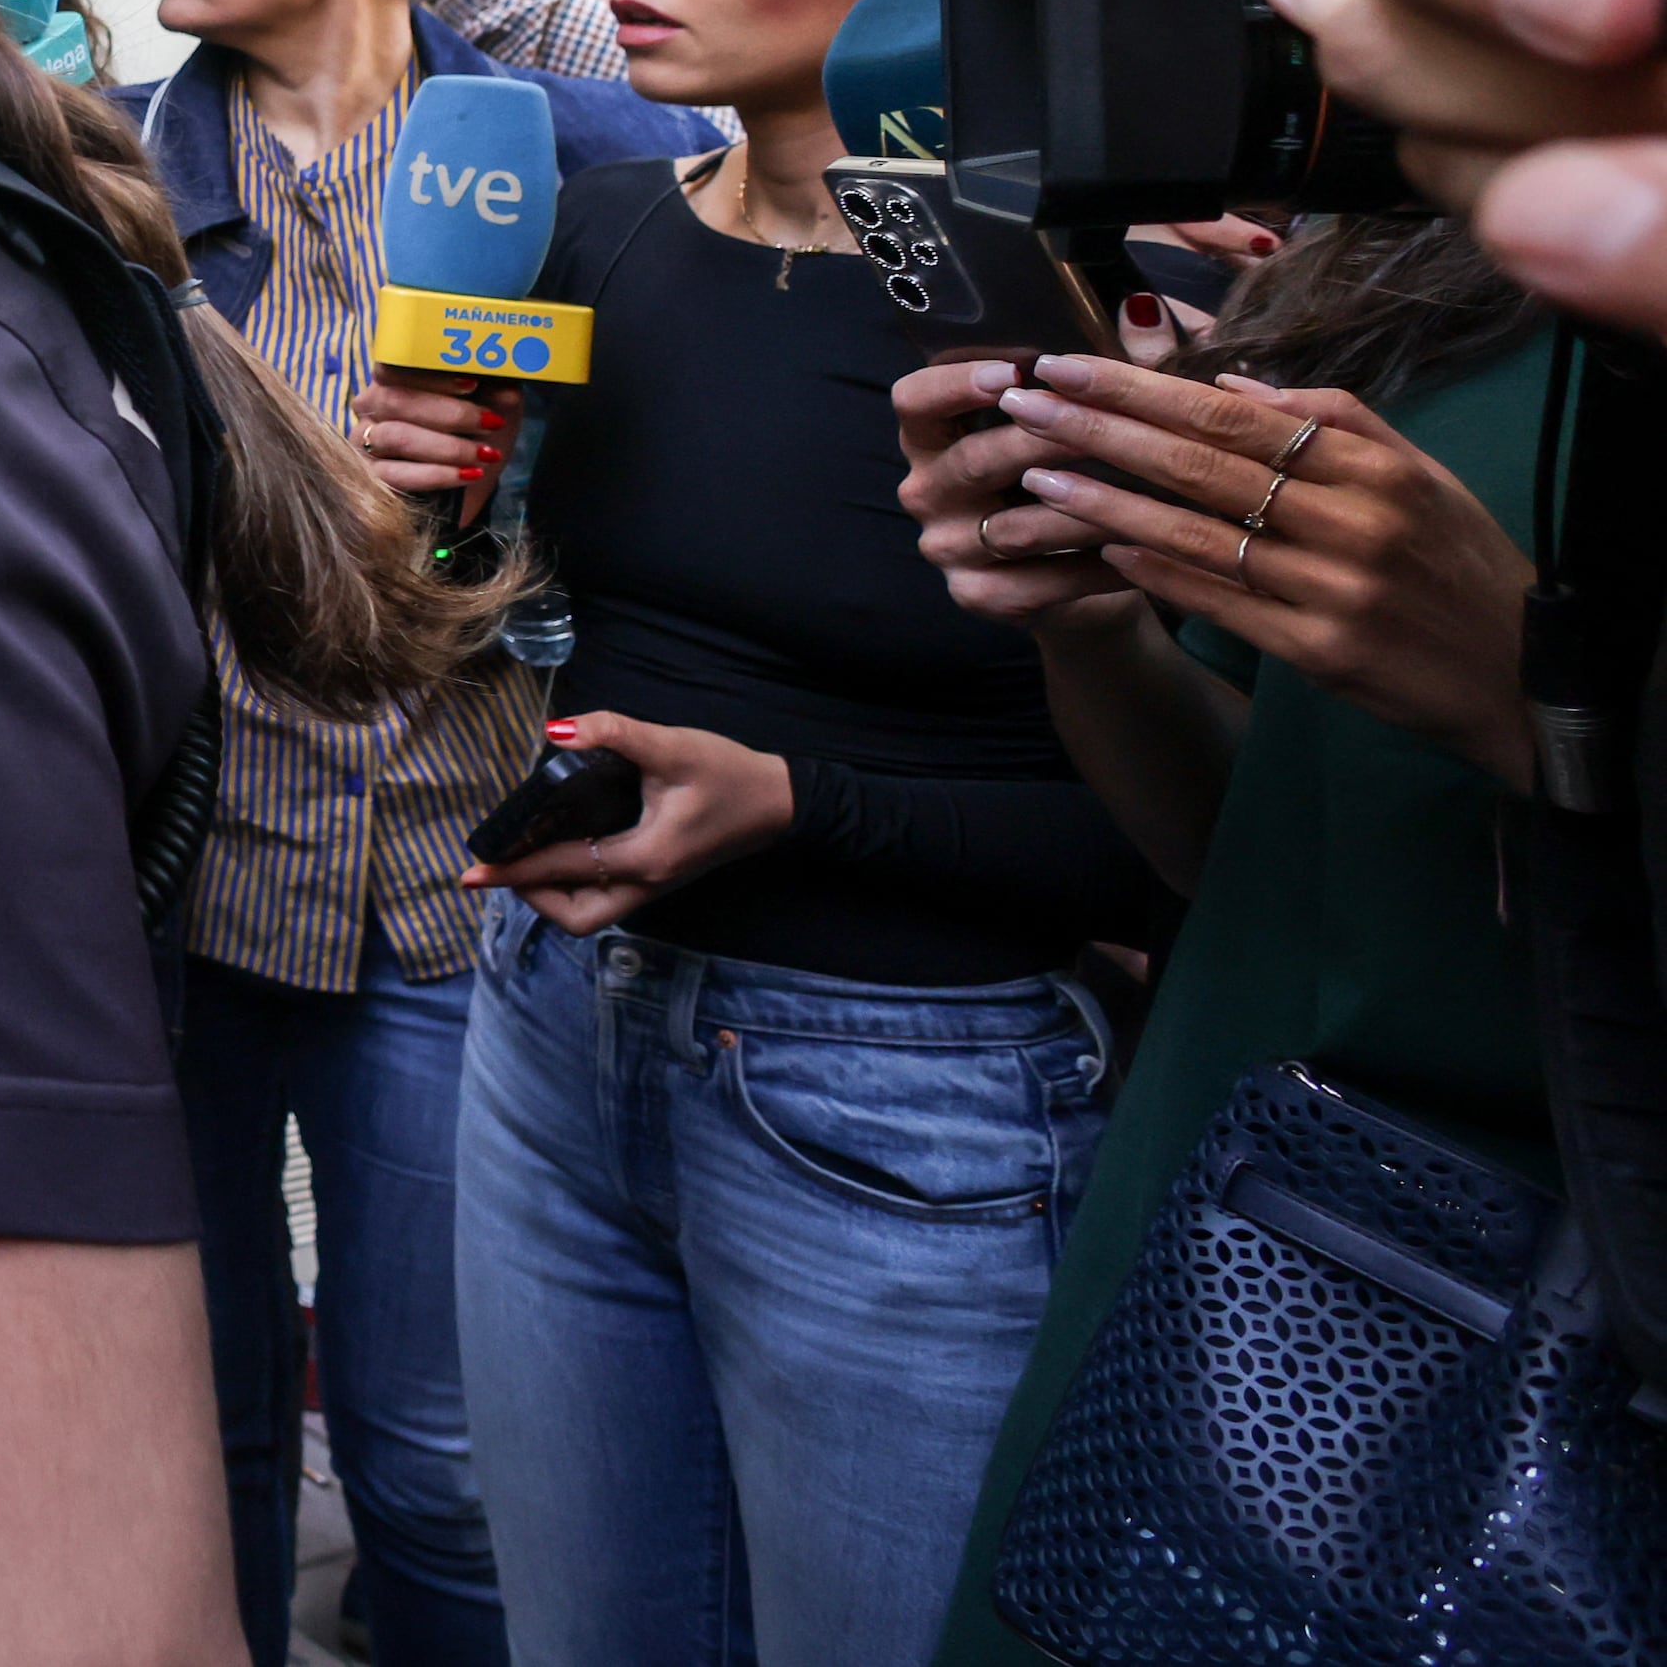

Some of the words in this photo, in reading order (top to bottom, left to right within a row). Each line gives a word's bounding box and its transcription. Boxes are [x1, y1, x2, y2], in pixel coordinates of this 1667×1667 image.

[408, 151, 523, 225] tve
[444, 306, 555, 329] MAÑANEROS
[439, 328, 551, 373] 360
